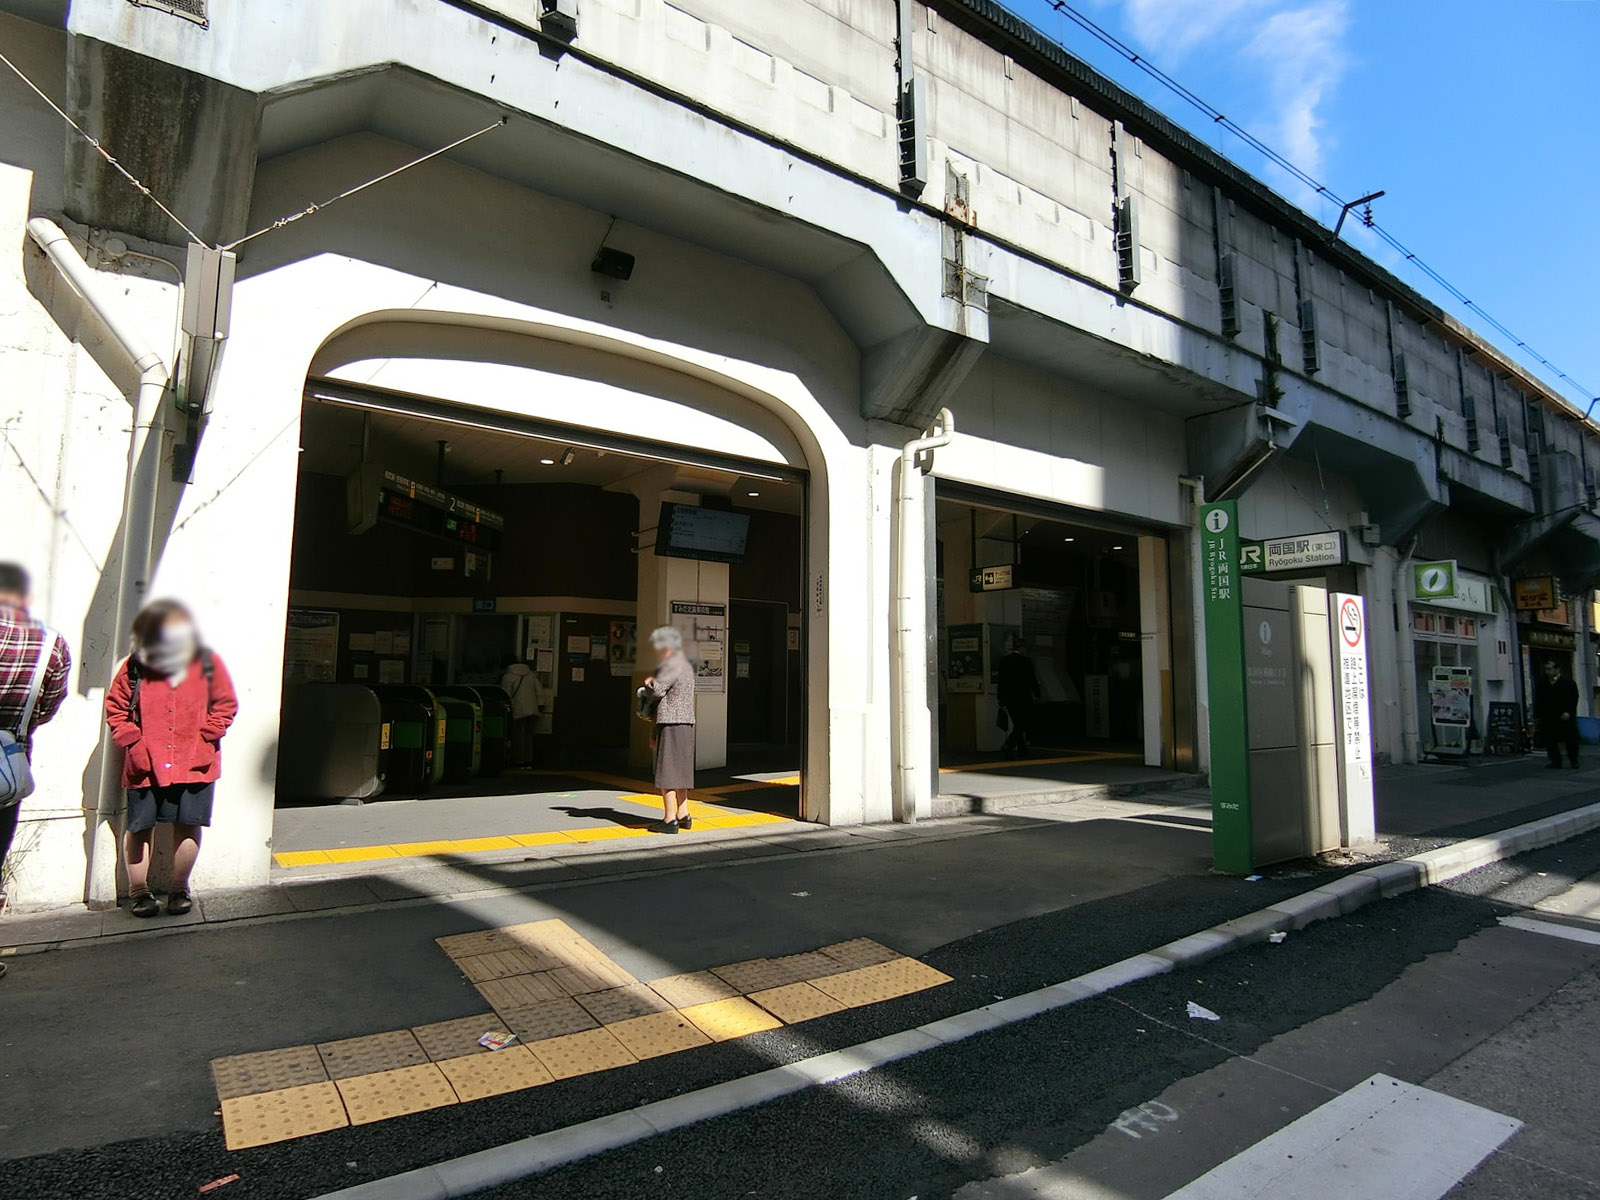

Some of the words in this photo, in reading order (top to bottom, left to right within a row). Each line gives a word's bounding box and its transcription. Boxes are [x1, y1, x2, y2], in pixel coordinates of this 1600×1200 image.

[449, 497, 455, 512] 2
[1208, 540, 1216, 551] JR
[1239, 545, 1262, 565] JR
[1305, 553, 1336, 564] Station
[1217, 539, 1231, 600] JR両国駅
[1358, 657, 1366, 700] ここは
